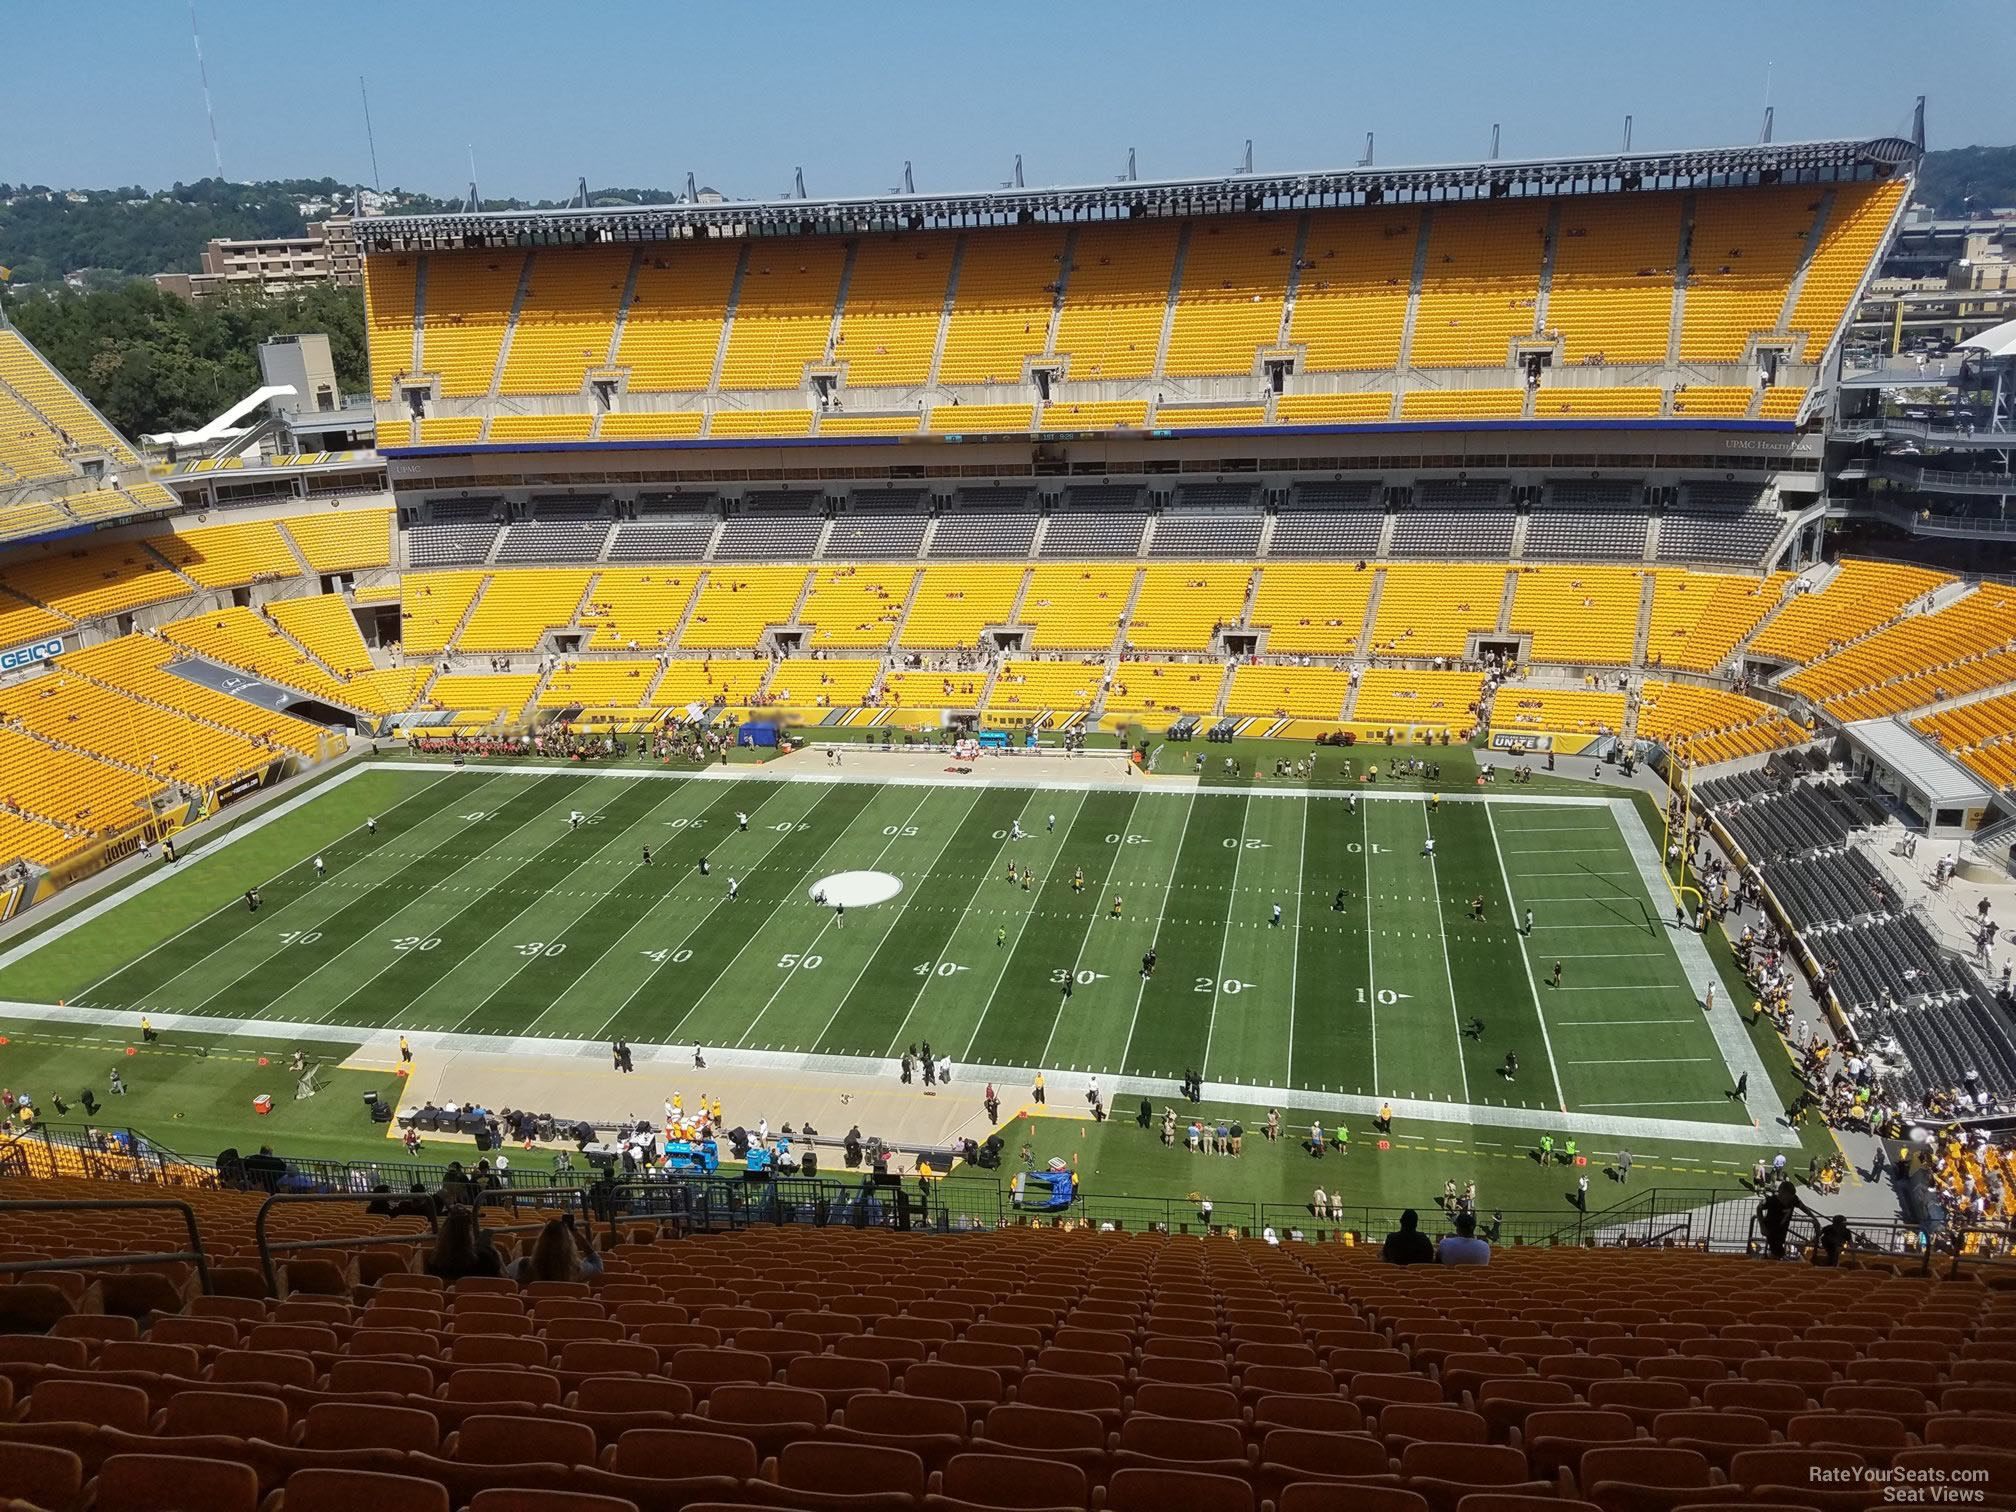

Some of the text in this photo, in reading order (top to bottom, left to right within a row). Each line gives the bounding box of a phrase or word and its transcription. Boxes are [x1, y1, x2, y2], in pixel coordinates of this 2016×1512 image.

[1725, 440, 1755, 449] UPMC
[396, 465, 422, 473] UPMC
[1, 640, 62, 669] GEICO
[671, 818, 708, 829] 30
[882, 825, 919, 837] 50
[1105, 833, 1142, 844] 30
[1222, 838, 1261, 849] 20
[1346, 843, 1380, 854] 10
[280, 931, 323, 944] 10
[393, 936, 442, 950] 20
[519, 942, 567, 956] 30
[649, 948, 694, 963] 40
[776, 953, 823, 969] 50
[912, 961, 957, 976] 40
[1049, 968, 1095, 985] 30
[1193, 977, 1242, 994] 20
[1355, 988, 1397, 1005] 10
